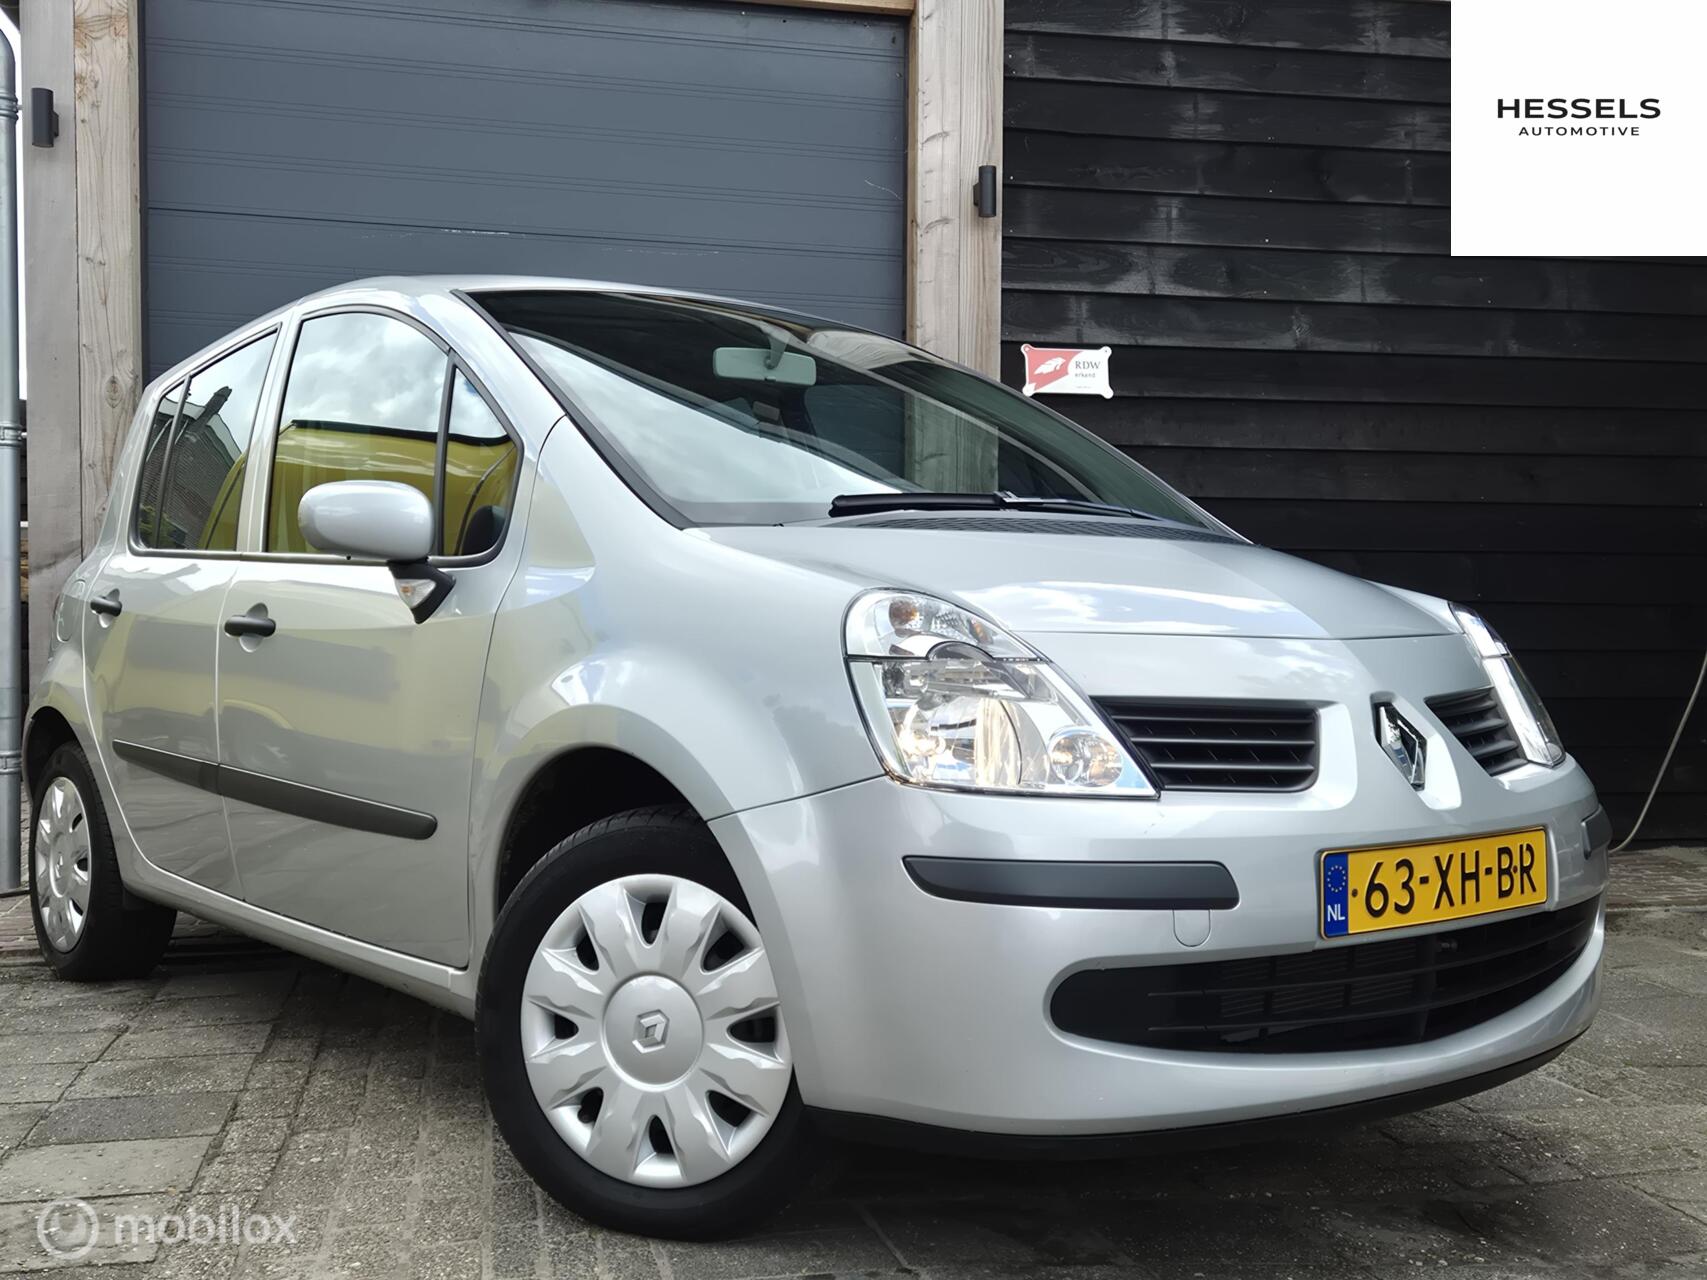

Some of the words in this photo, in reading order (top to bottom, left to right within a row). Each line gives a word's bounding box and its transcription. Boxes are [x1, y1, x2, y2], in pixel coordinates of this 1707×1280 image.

[1075, 361, 1101, 370] RDW
[1365, 843, 1537, 918] 63-XH-BR
[1327, 904, 1346, 922] NL
